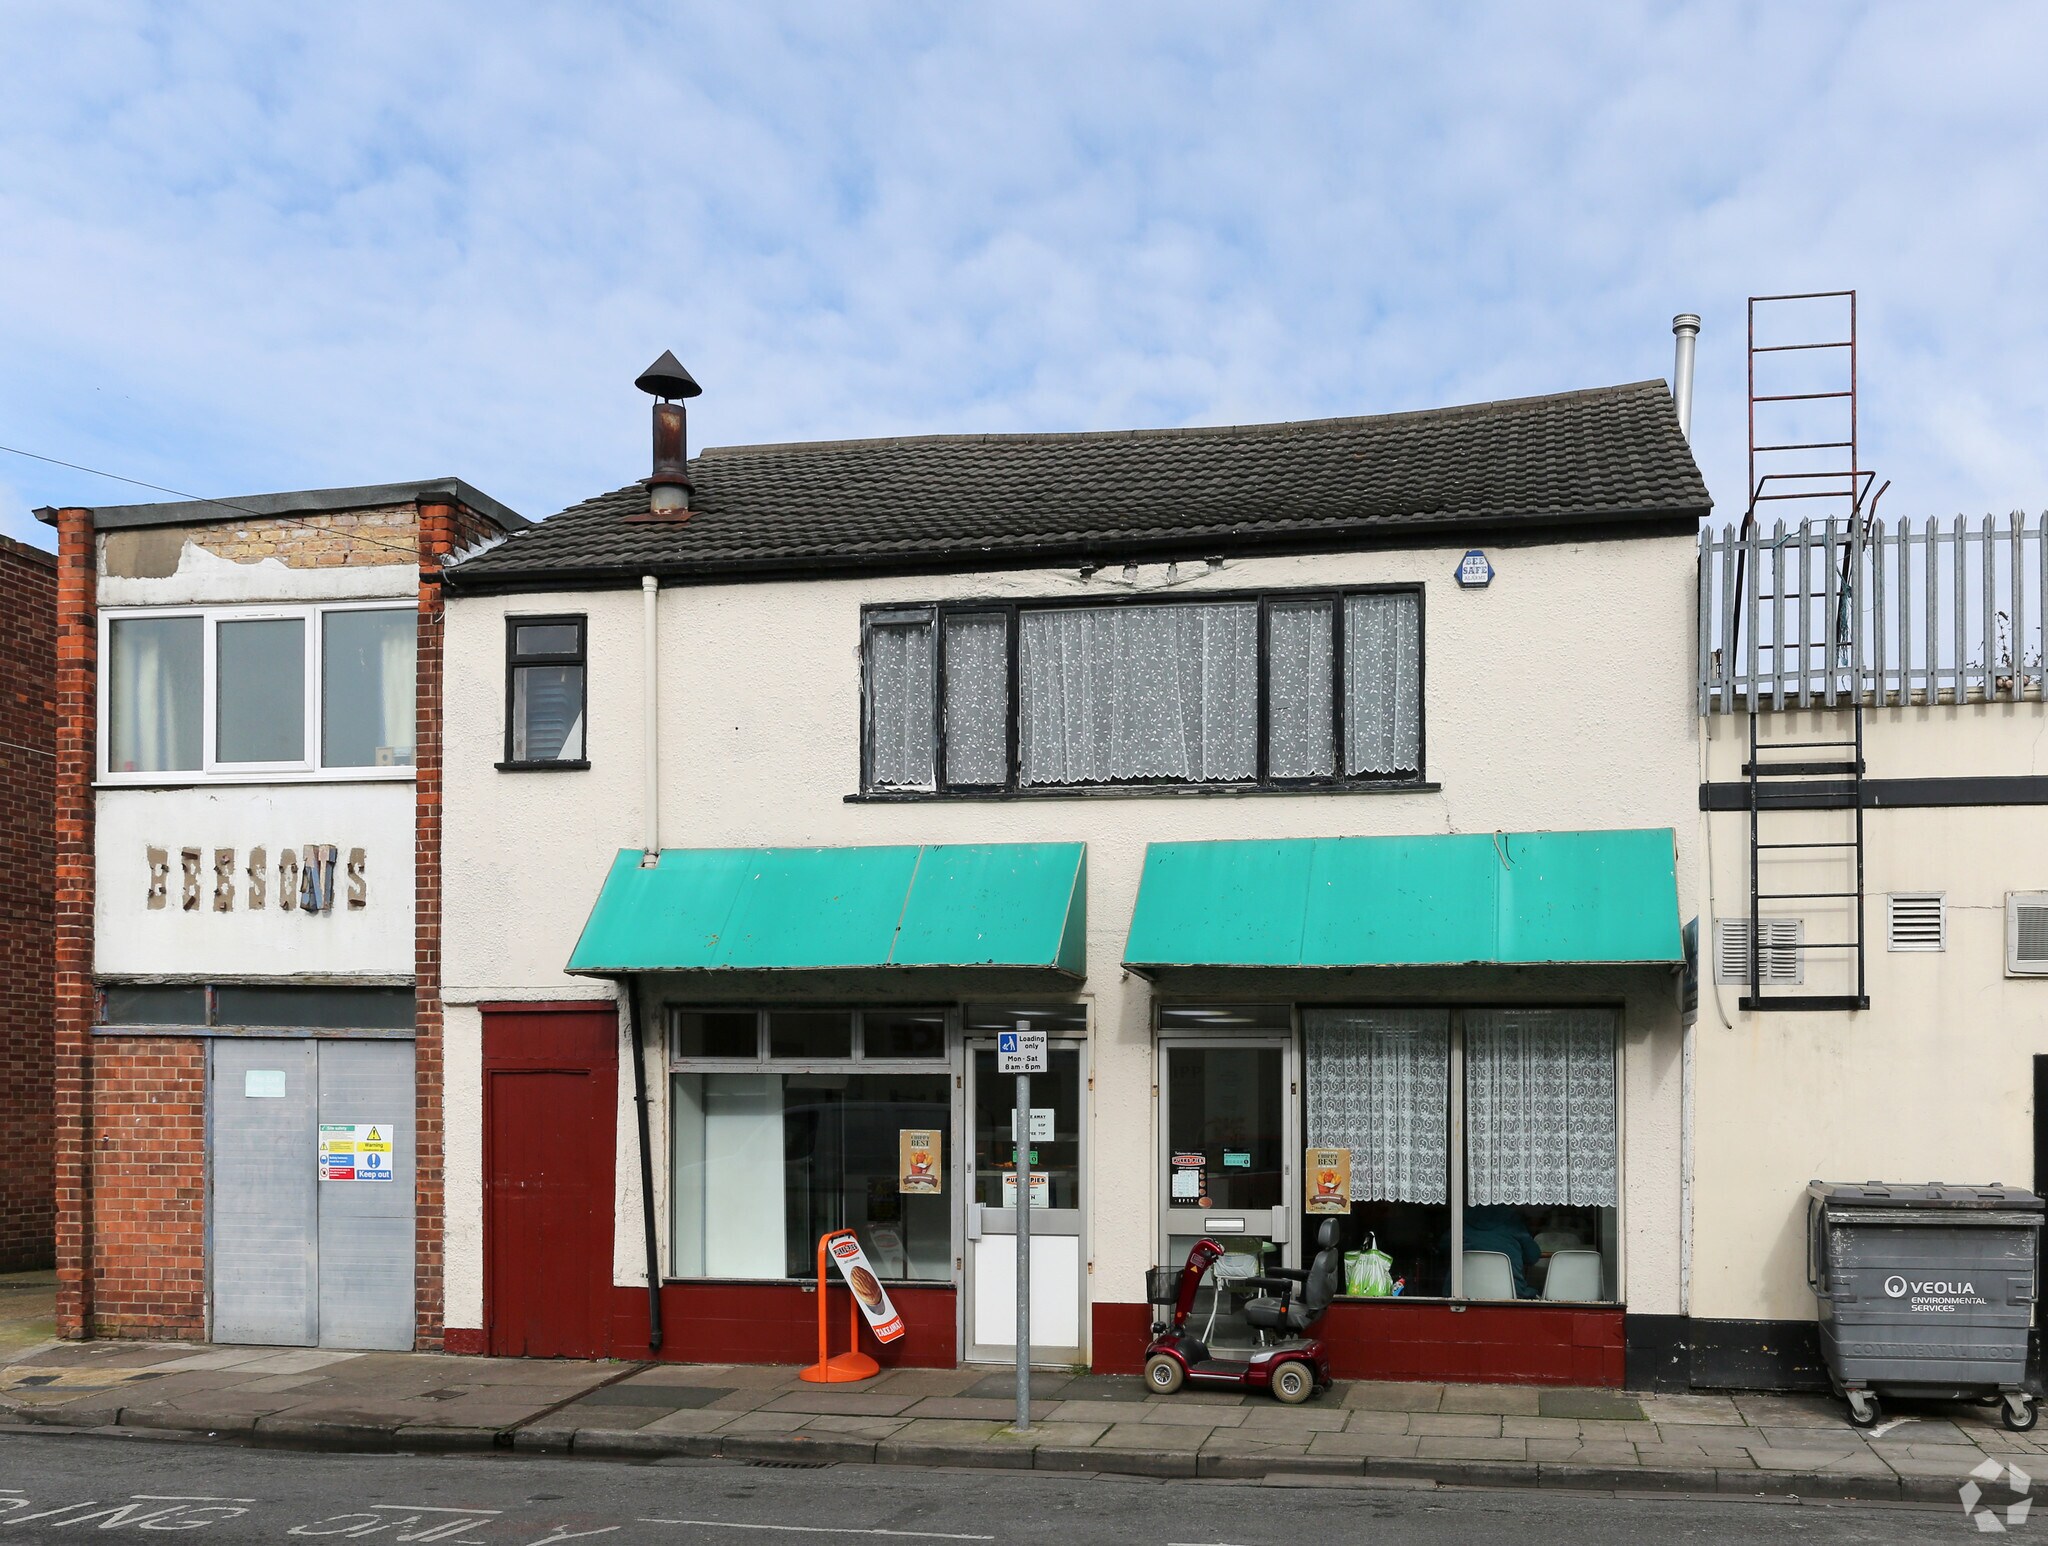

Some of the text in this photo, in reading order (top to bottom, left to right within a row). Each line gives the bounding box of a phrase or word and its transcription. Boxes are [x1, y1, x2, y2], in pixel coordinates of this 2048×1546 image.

[1463, 566, 1487, 574] SAFE
[359, 1170, 376, 1179] Keep
[1910, 1281, 1975, 1294] VEOLIA
[1911, 1297, 1987, 1305] ENVIRONMENTAL
[1911, 1304, 1955, 1312] SERVICES
